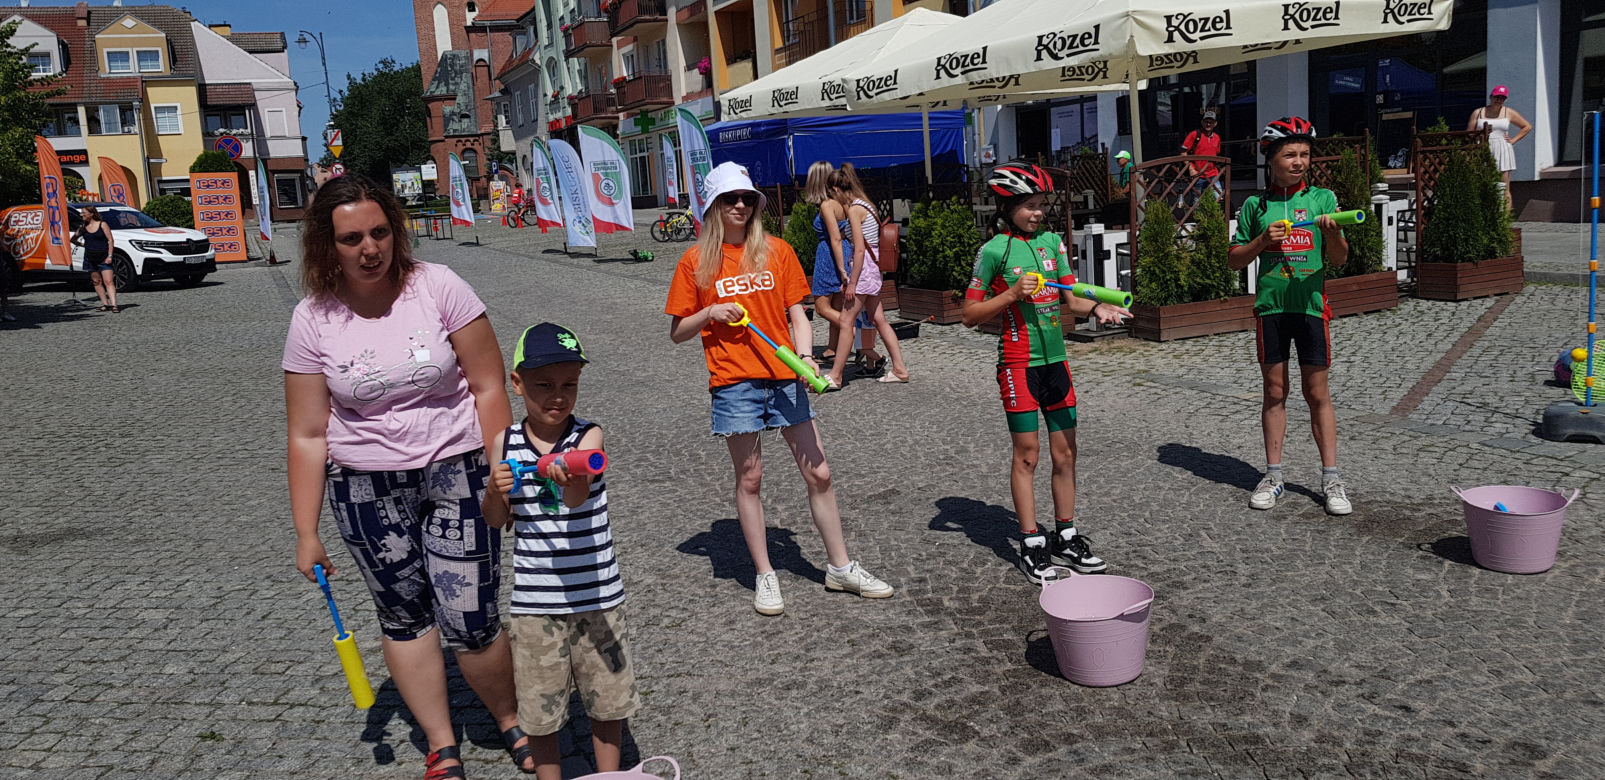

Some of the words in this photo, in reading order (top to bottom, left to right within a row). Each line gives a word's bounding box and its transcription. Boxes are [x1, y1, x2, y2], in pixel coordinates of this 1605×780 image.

[1281, 1, 1341, 31] Kozel
[1381, 0, 1434, 25] Kozel
[1163, 8, 1233, 44] Kozel
[1034, 24, 1101, 62] Kozel
[934, 45, 989, 80] Kozel
[820, 80, 846, 102] Koz
[855, 69, 898, 101] Kozel
[727, 94, 753, 116] Kozel
[771, 86, 799, 108] Kozel
[719, 127, 752, 143] BISKUPIEC
[57, 154, 87, 163] range
[10, 211, 43, 226] eska
[722, 272, 773, 294] eska
